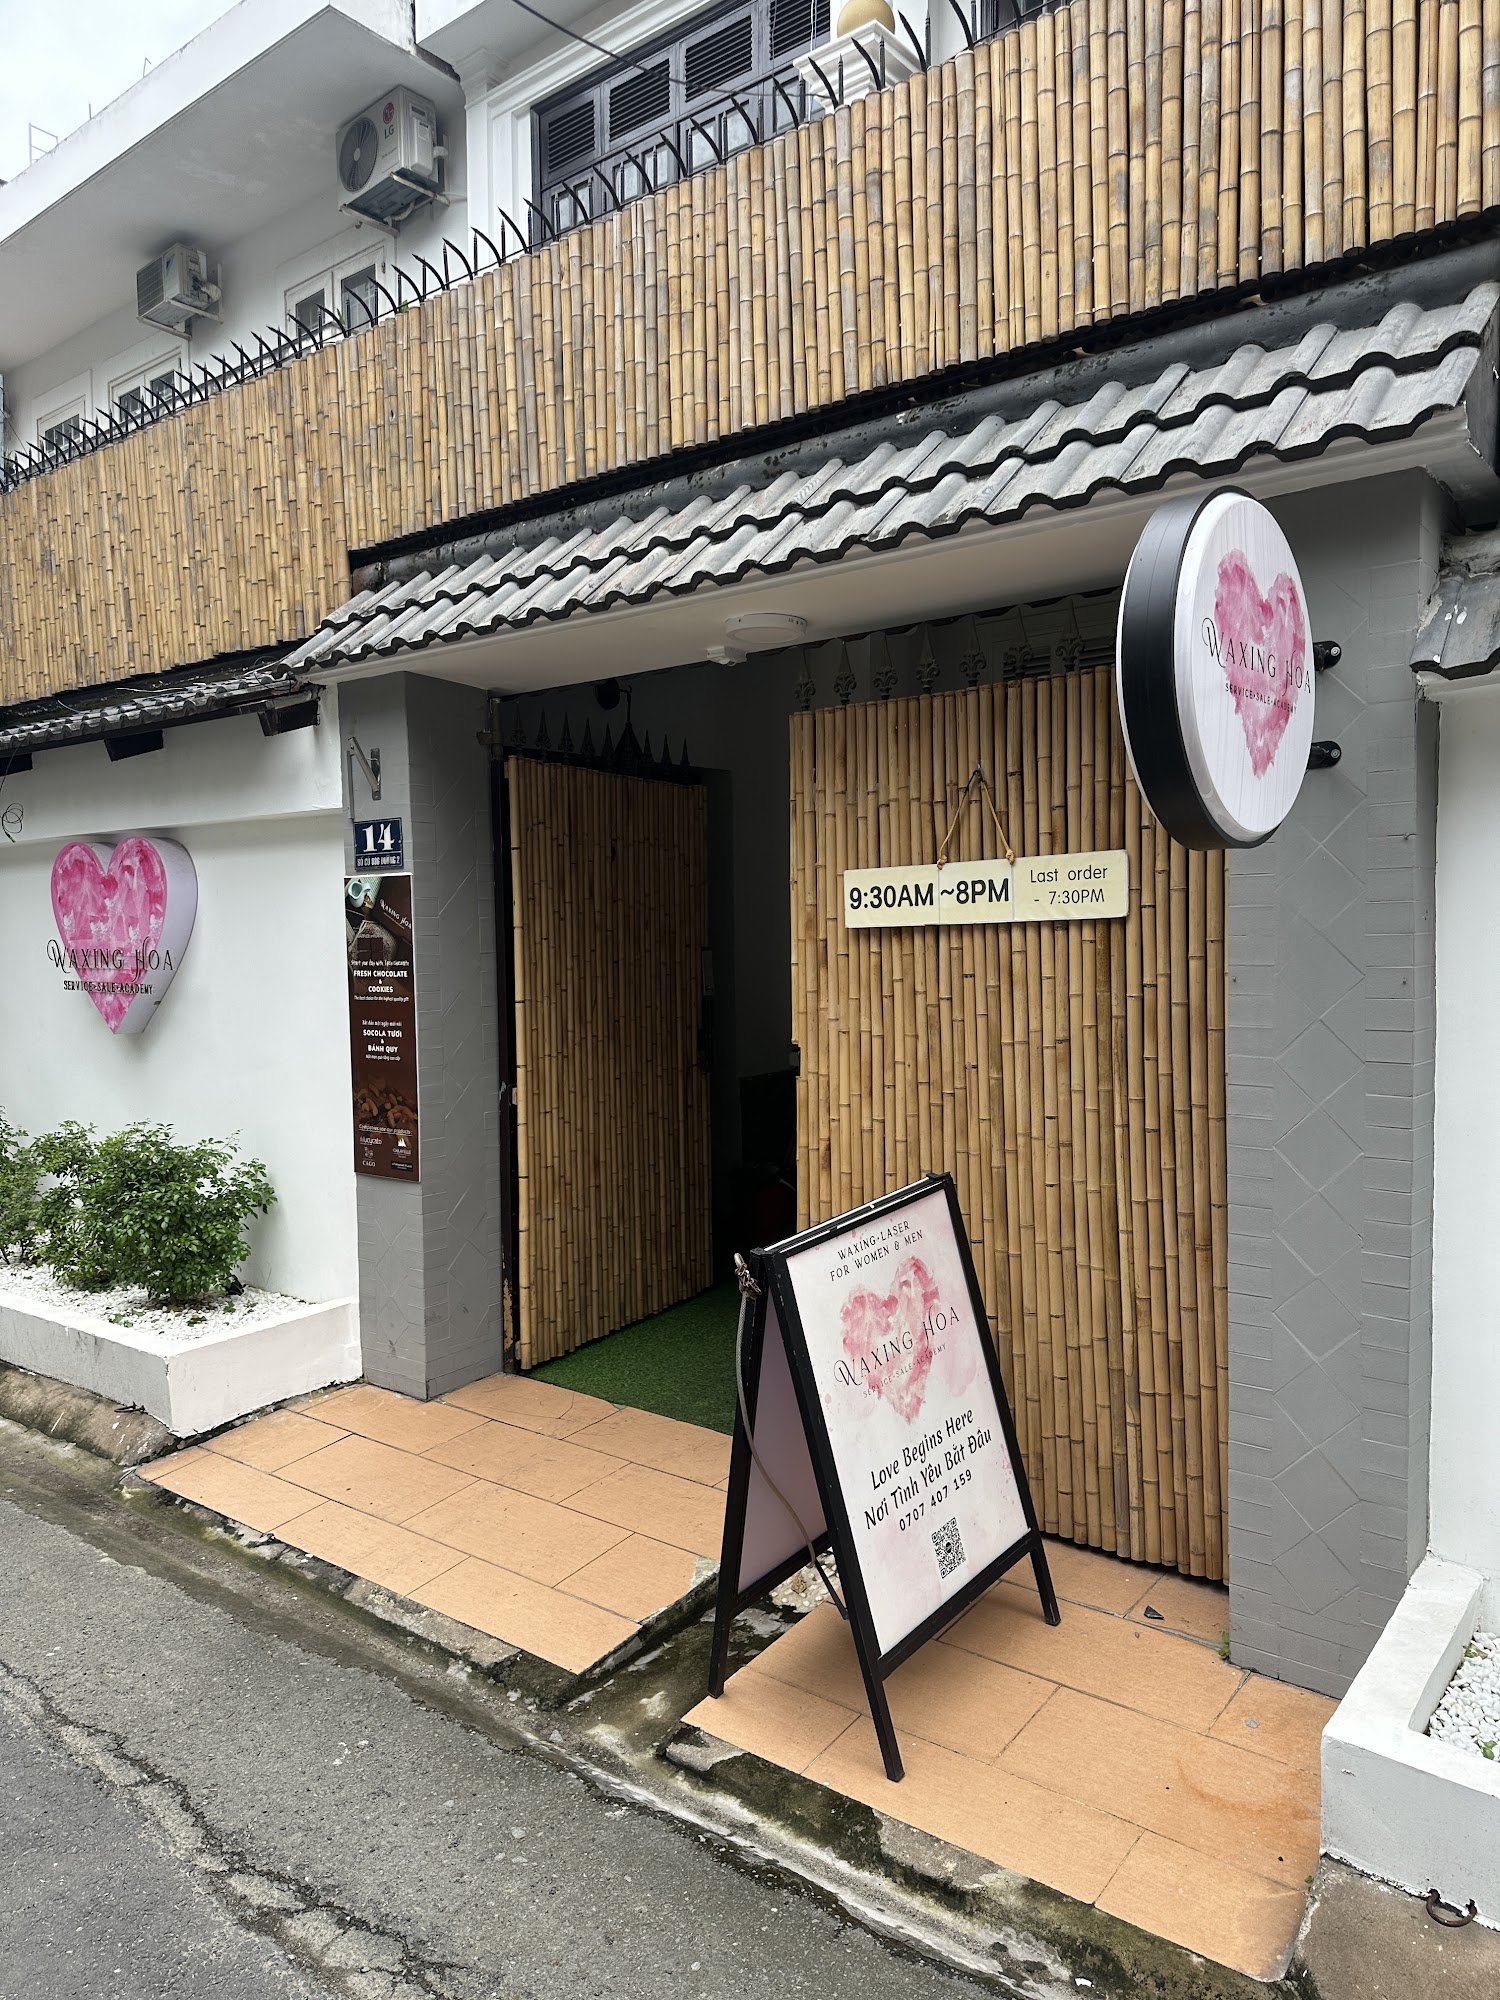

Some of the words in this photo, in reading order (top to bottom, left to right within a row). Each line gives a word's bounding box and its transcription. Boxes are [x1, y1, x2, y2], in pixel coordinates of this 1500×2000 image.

[384, 124, 395, 139] LG
[1201, 617, 1276, 678] WAXING
[1282, 650, 1311, 697] HOA
[362, 823, 395, 852] 14
[1030, 867, 1059, 883] Last
[1067, 865, 1108, 881] order
[850, 883, 934, 909] 9:30AM
[1048, 888, 1105, 906] 7:30PM
[47, 939, 124, 973] WAXING
[132, 936, 174, 982] HOA
[373, 970, 408, 978] CHOCOLATE
[363, 1029, 386, 1037] SOCOLA
[367, 1043, 384, 1052] BÁNH
[385, 1045, 399, 1053] QUY
[830, 1265, 850, 1281] FOR
[854, 1245, 890, 1269] WOMEN
[904, 1229, 923, 1246] MEN
[833, 1330, 914, 1386] WAXING
[922, 1305, 960, 1351] HOA
[870, 1459, 900, 1491] Love
[902, 1429, 943, 1467] Begins
[945, 1409, 974, 1437] Here
[864, 1498, 889, 1529] Nơi
[891, 1476, 920, 1510] Tình
[920, 1463, 942, 1487] Yêu
[944, 1444, 966, 1470] Bắt
[899, 1503, 925, 1531] 0707
[930, 1485, 949, 1507] 407
[953, 1469, 972, 1491] 159
